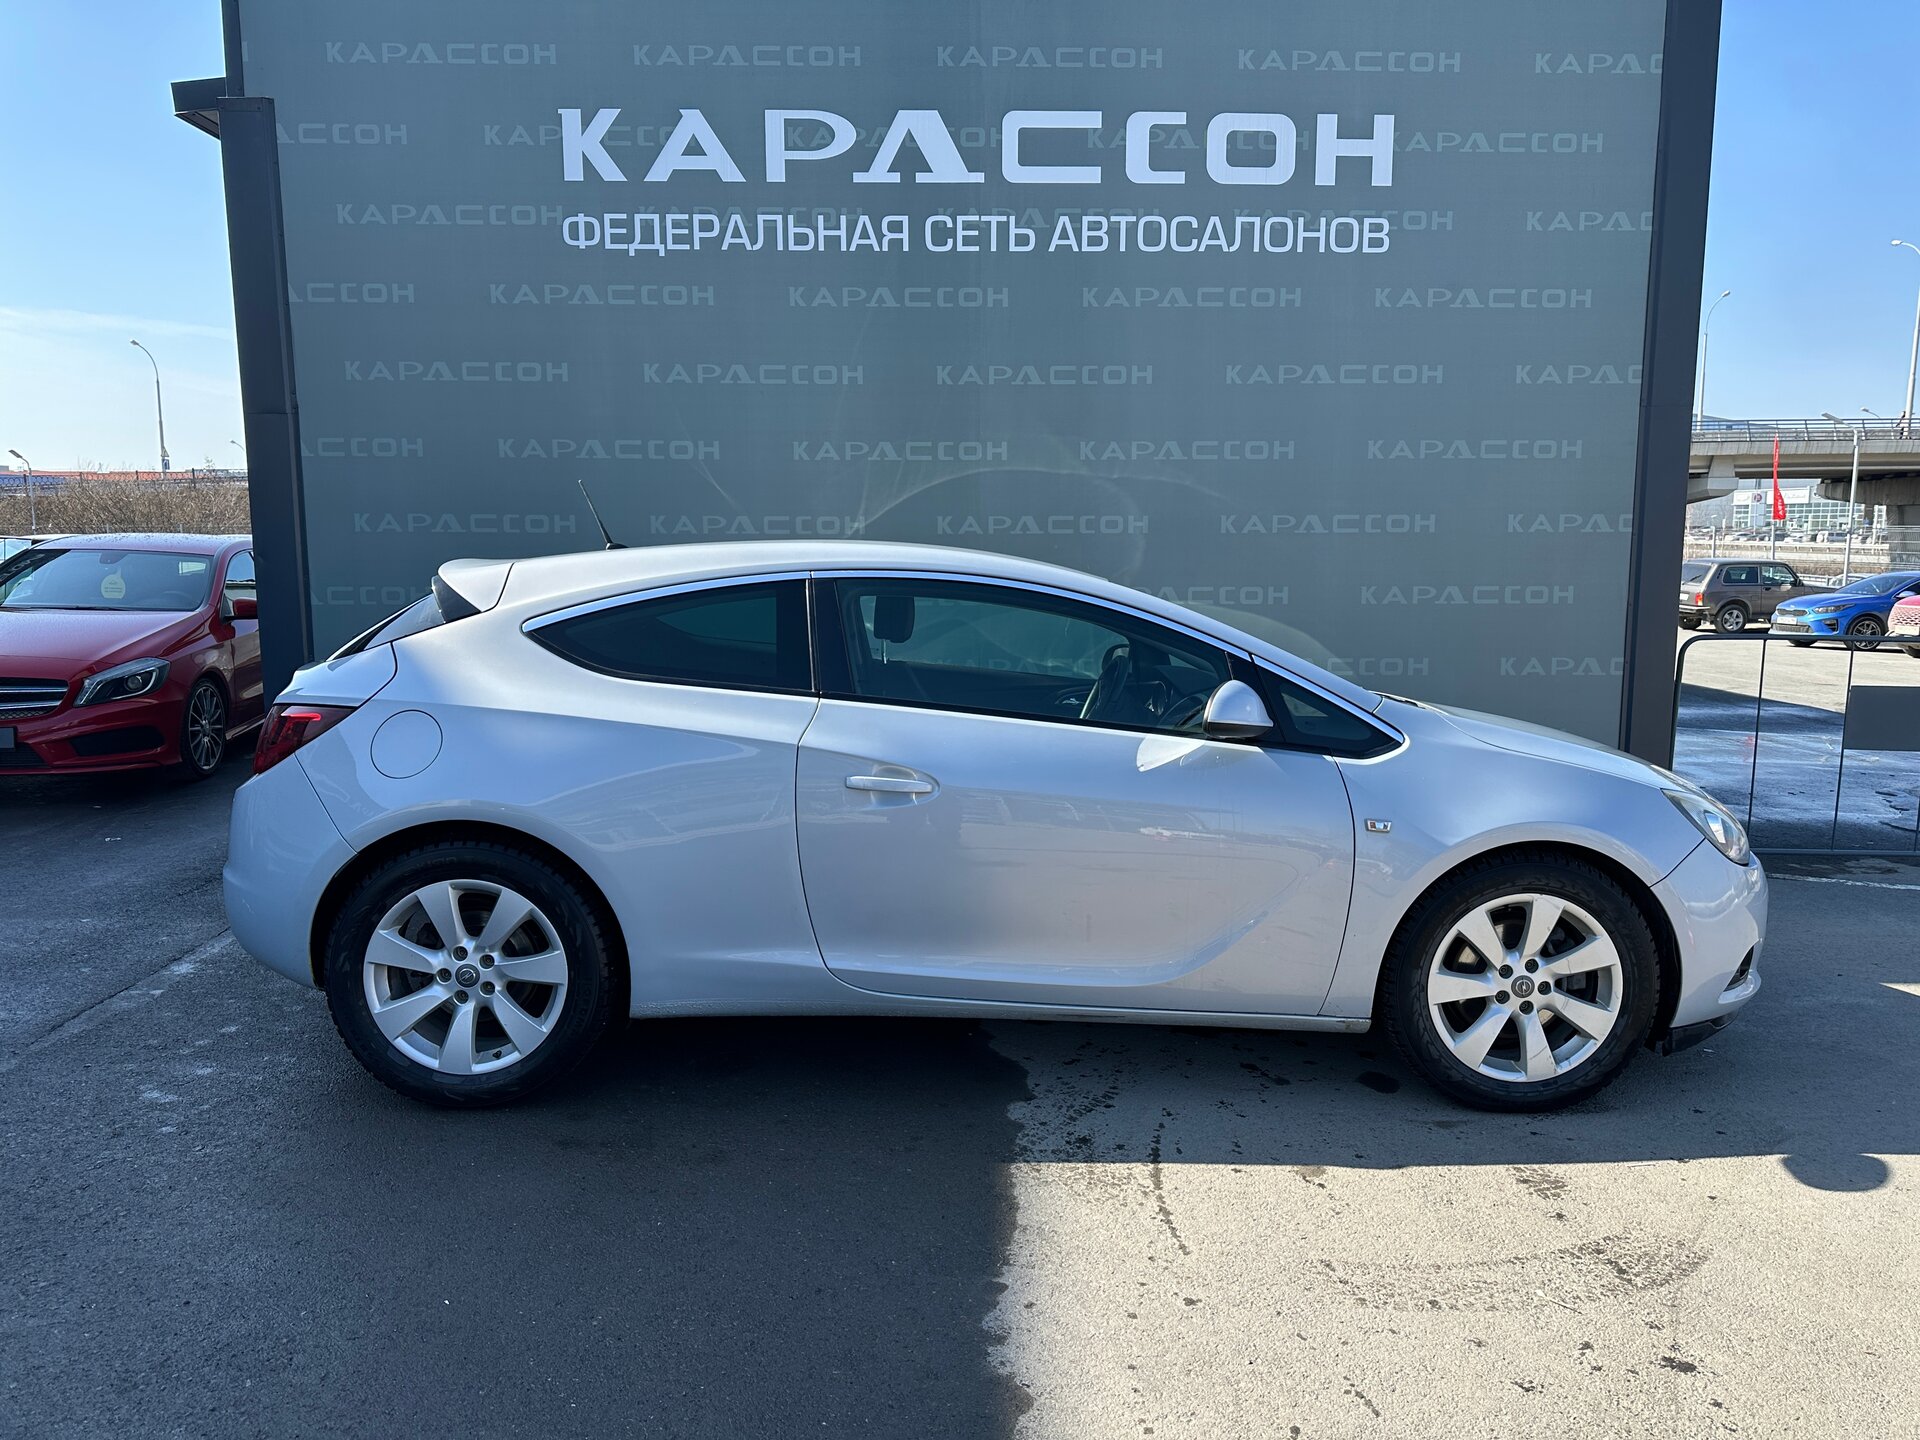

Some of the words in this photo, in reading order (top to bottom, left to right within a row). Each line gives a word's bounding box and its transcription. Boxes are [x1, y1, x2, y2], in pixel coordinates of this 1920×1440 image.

[1394, 132, 1603, 153] АРЛССОН
[563, 214, 908, 256] ФЕДЕРАЛЬНАЯ
[925, 215, 1035, 251] СЕТЬ
[1048, 216, 1389, 253] АВТОСАЛОНОВ
